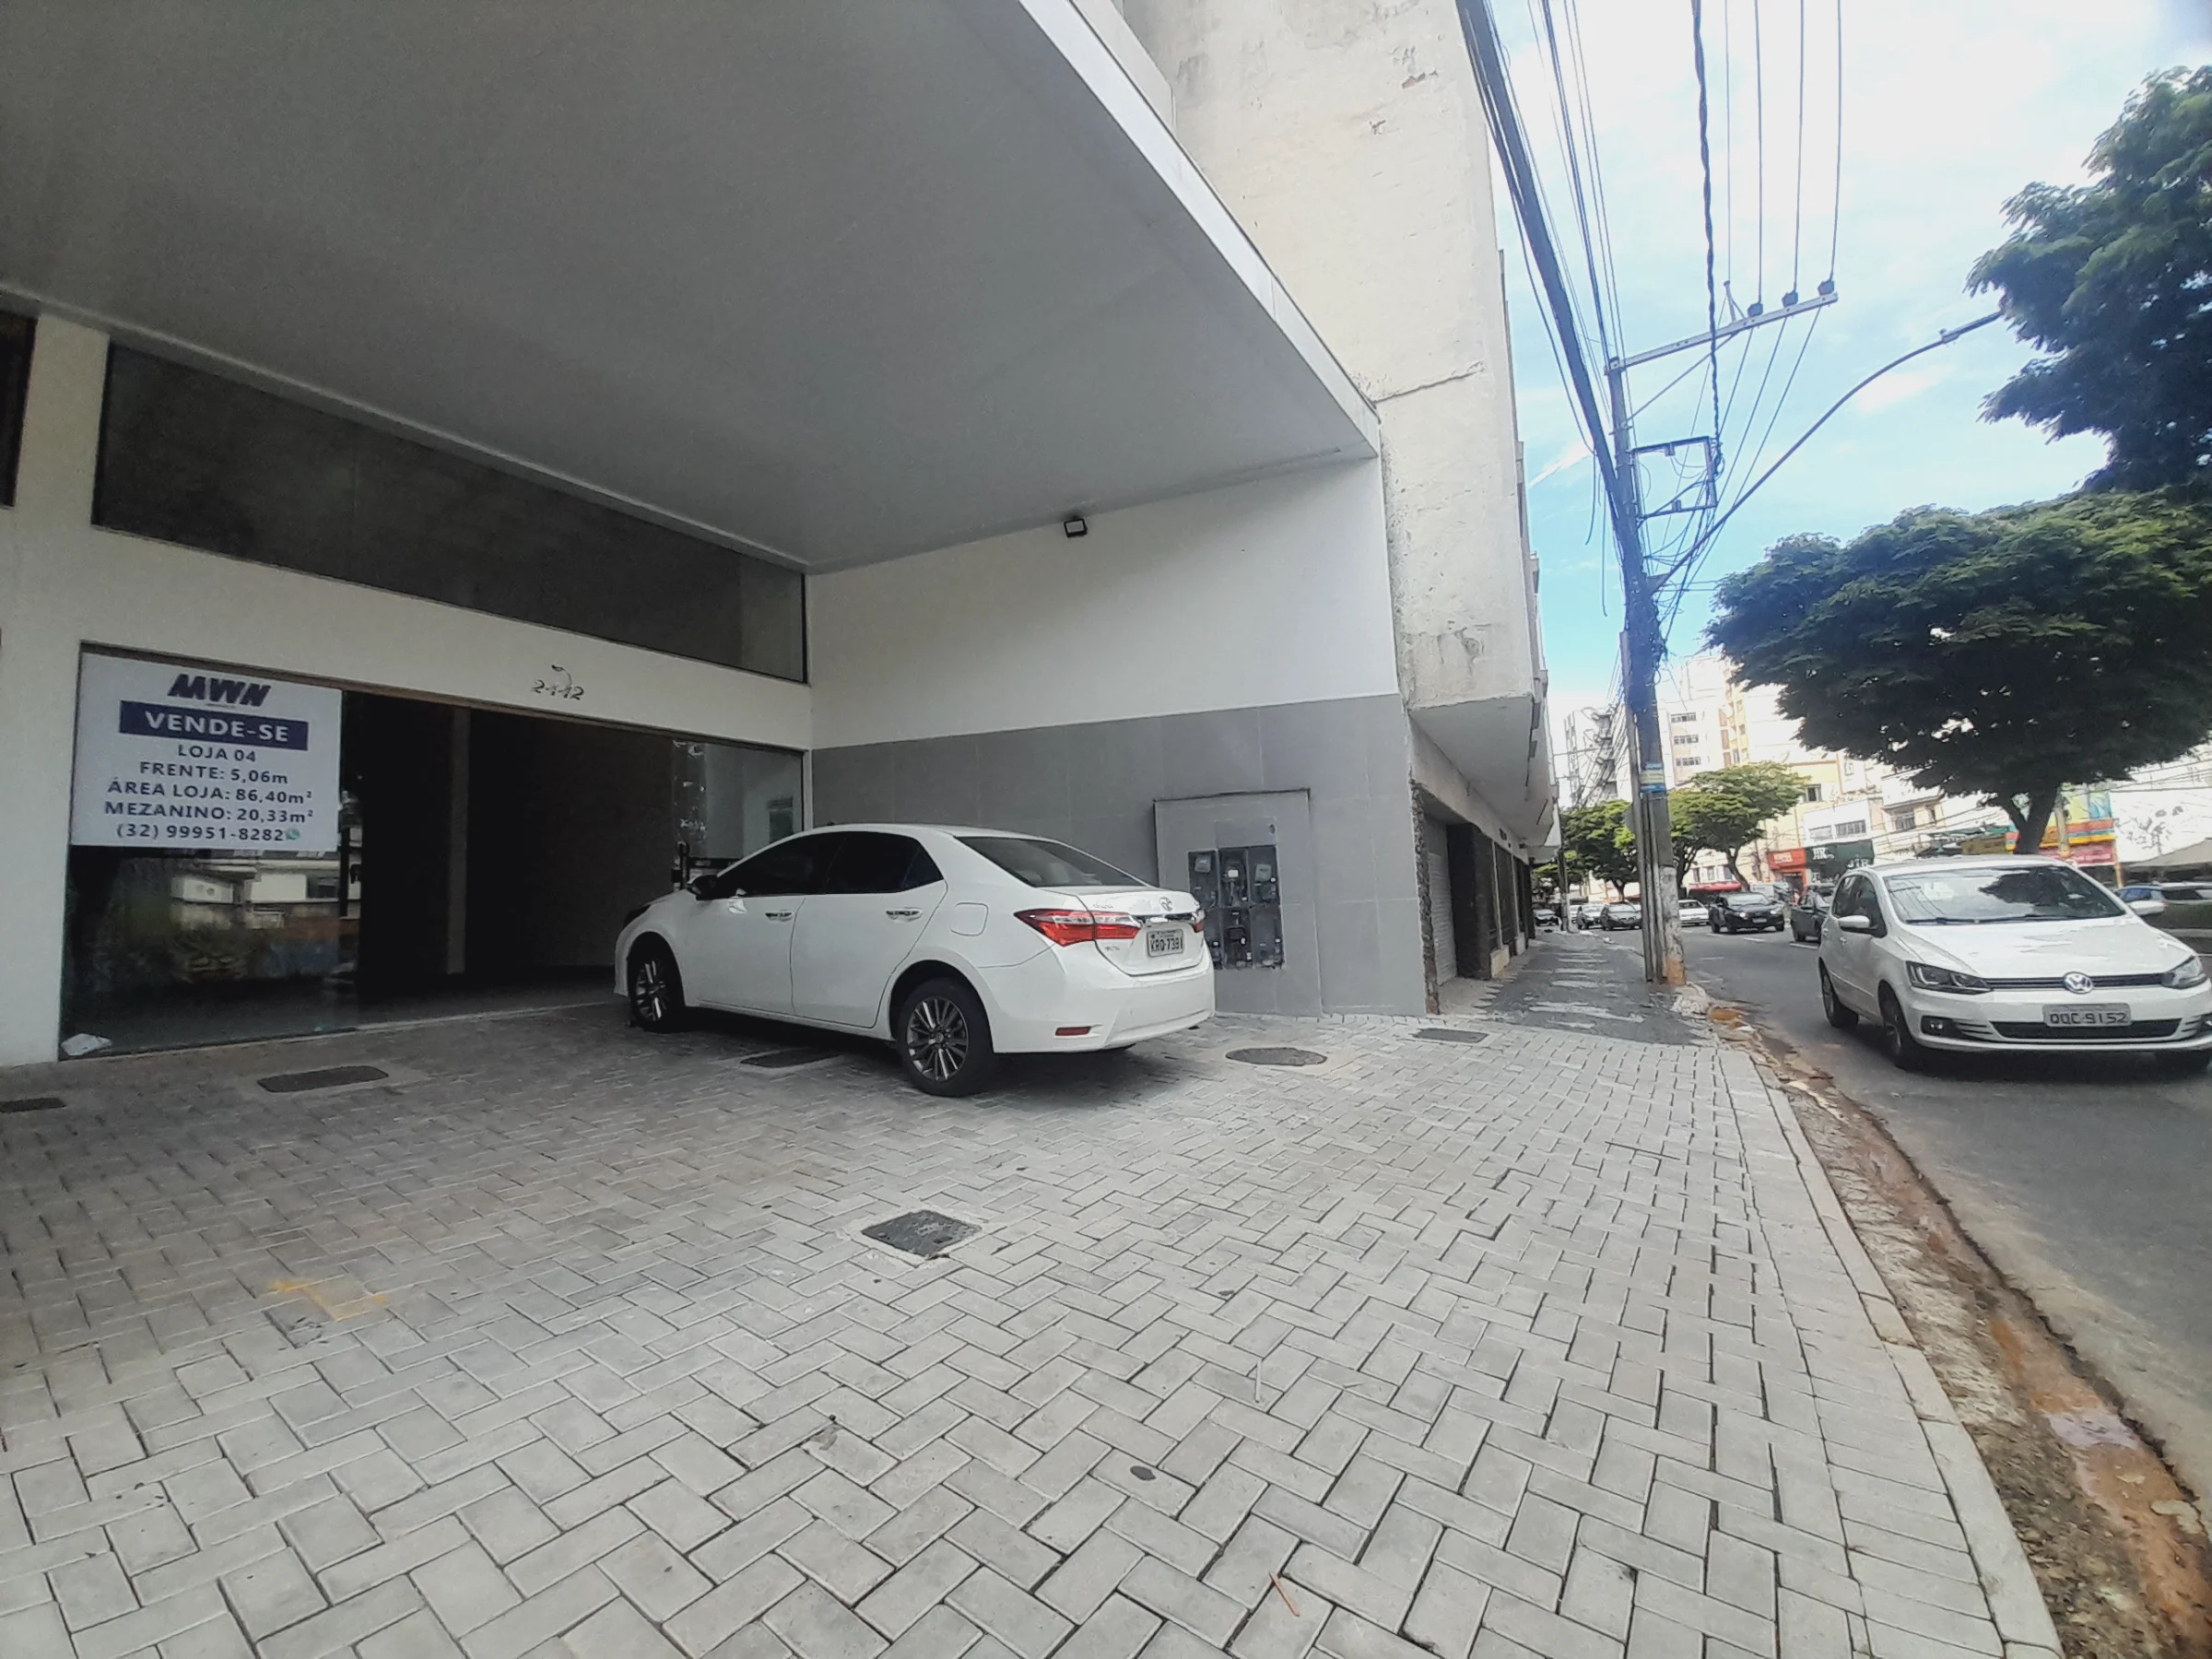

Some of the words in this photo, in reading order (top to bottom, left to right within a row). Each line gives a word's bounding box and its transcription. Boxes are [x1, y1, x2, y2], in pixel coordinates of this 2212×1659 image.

[167, 673, 272, 707] MWN
[145, 710, 289, 742] VENDE-SE
[178, 744, 228, 760] LOJA
[234, 748, 257, 762] 04
[139, 761, 225, 780] FRENTE:
[230, 769, 288, 784] 5,06m
[107, 776, 165, 795] ÁREA
[172, 783, 230, 800] LOJA:
[235, 788, 312, 805] 86,40m²
[104, 801, 231, 820] MEZANINO:
[236, 808, 314, 823] 20,33m²
[116, 823, 159, 839] (32)
[166, 825, 284, 841] 99951-8282
